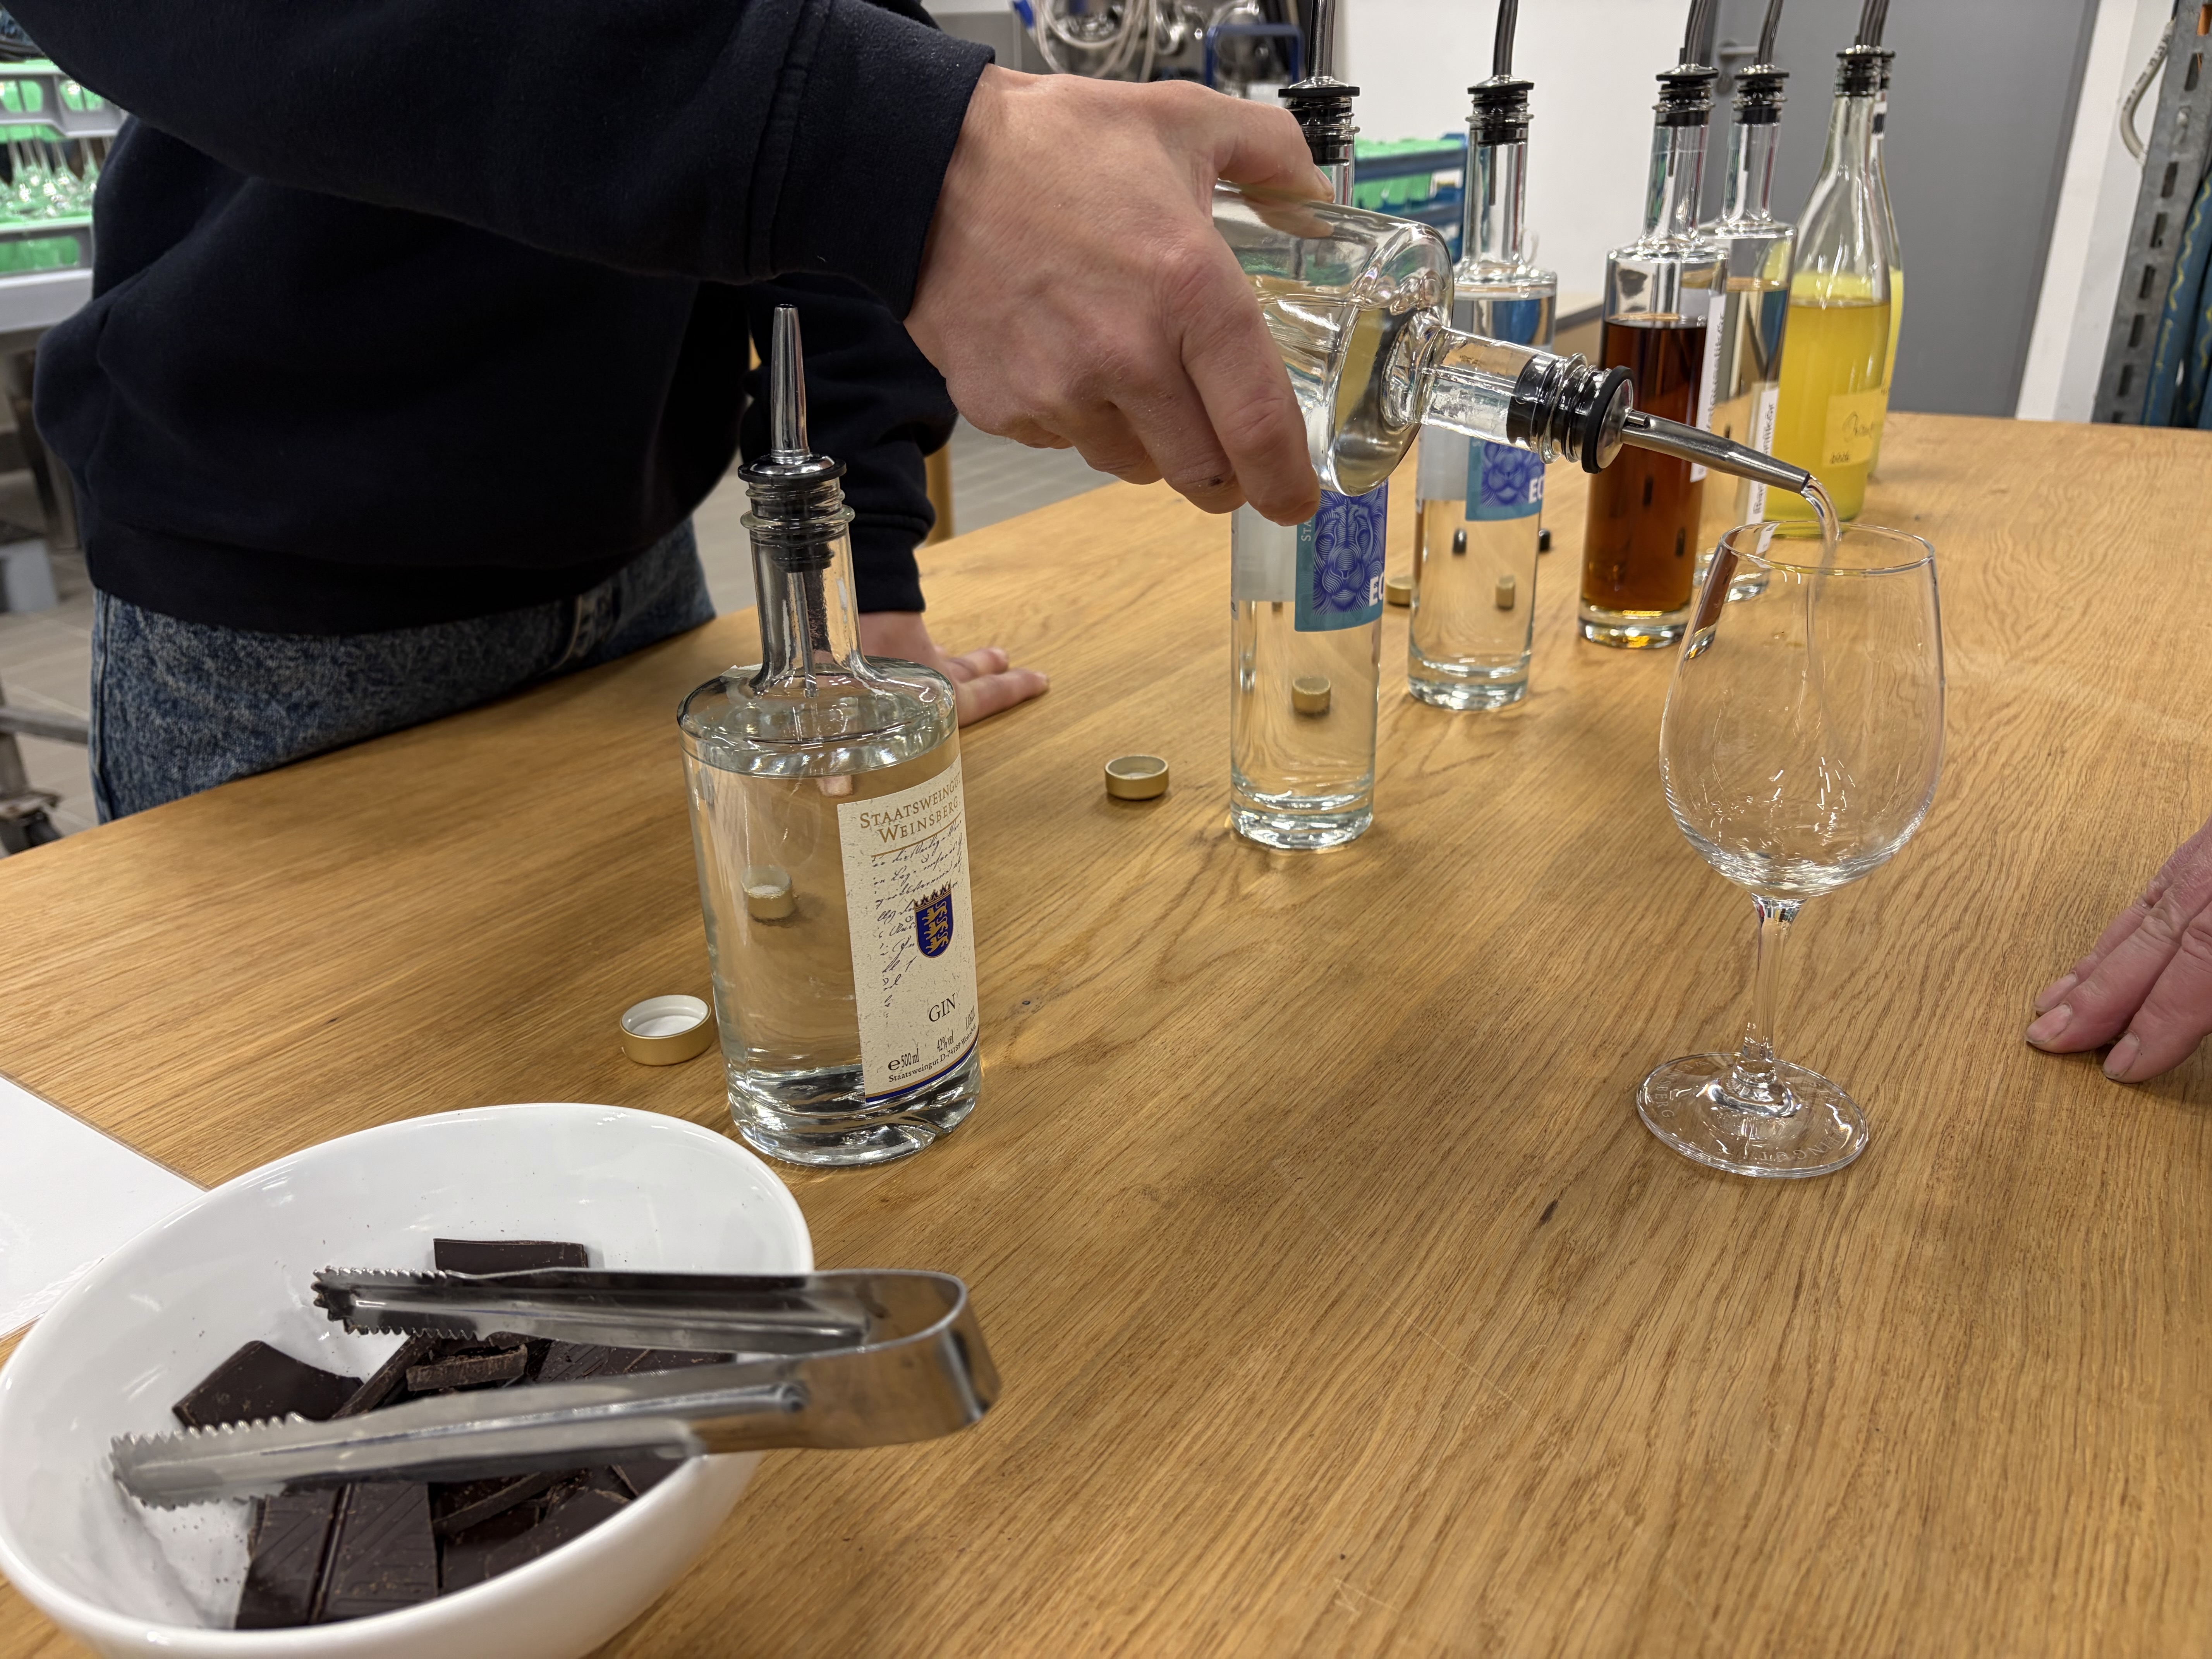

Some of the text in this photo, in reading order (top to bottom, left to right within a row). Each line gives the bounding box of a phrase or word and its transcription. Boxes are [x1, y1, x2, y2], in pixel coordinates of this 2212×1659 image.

[1301, 520, 1312, 541] STA
[860, 771, 960, 829] STAATSWEINGUT
[877, 796, 958, 843] WEINSBERG
[929, 993, 955, 1022] GIN
[889, 1058, 939, 1082] Staatsweingut
[940, 1042, 961, 1062] D-74189
